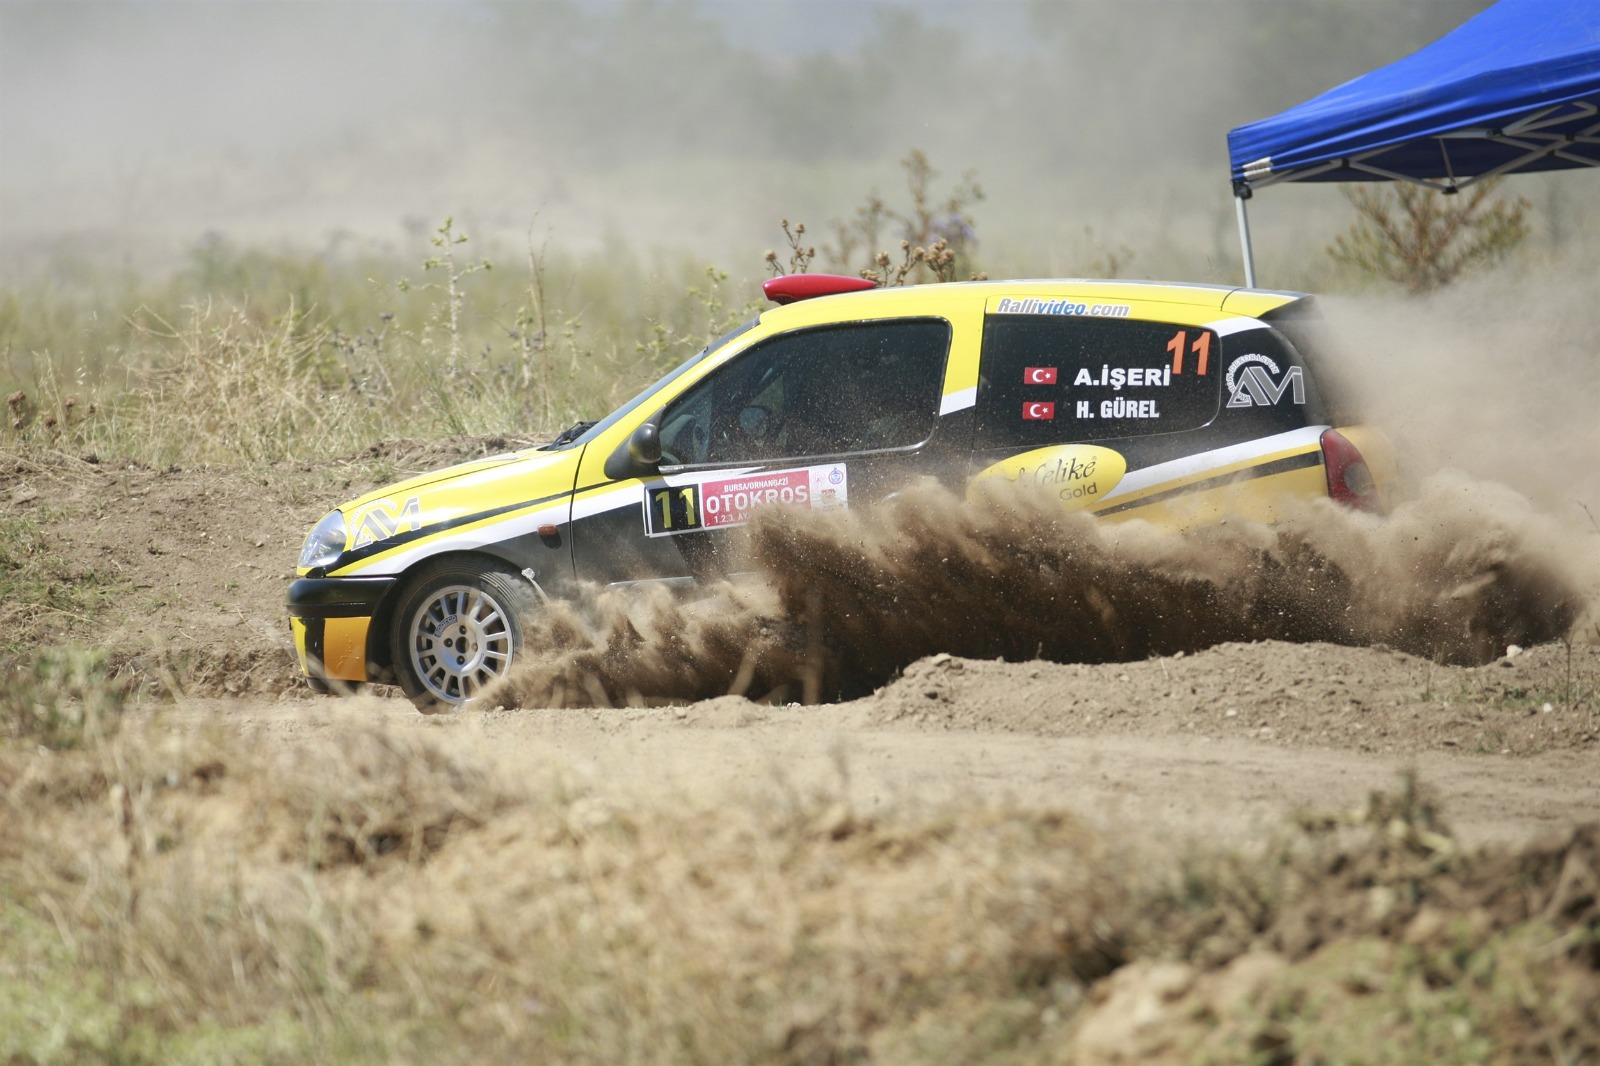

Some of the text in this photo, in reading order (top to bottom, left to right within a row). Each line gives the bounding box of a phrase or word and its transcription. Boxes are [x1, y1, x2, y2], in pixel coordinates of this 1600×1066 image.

[997, 298, 1130, 317] Rallivideo.com
[1166, 330, 1211, 376] 11
[1073, 364, 1171, 391] A.İŞERİ
[1076, 396, 1160, 419] H. GÜREL
[706, 485, 808, 514] OTOKROS
[1060, 482, 1098, 500] Gold
[655, 487, 696, 529] 11
